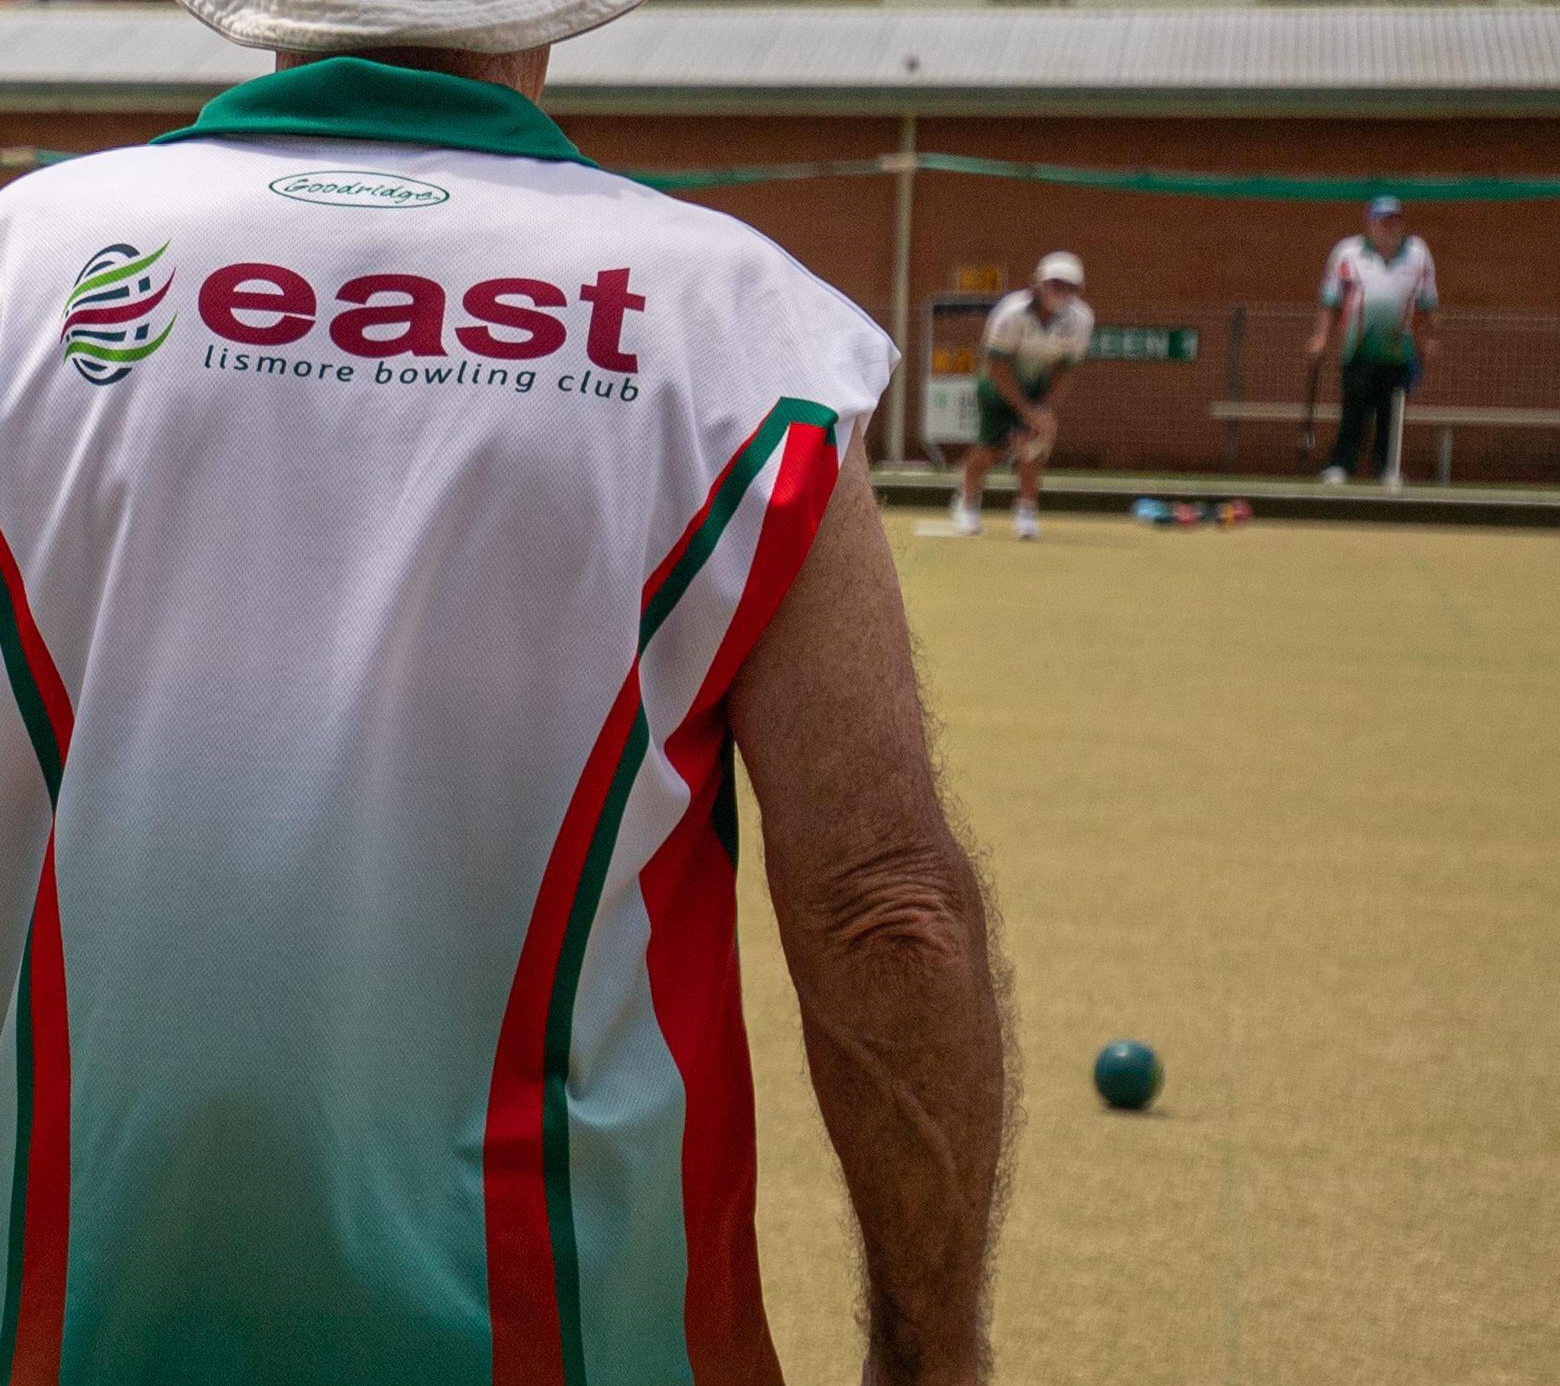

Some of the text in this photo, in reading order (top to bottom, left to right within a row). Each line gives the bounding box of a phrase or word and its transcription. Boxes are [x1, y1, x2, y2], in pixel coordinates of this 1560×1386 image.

[283, 178, 433, 204] Goodridge
[197, 262, 646, 374] east
[204, 344, 639, 403] lismore bowling club
